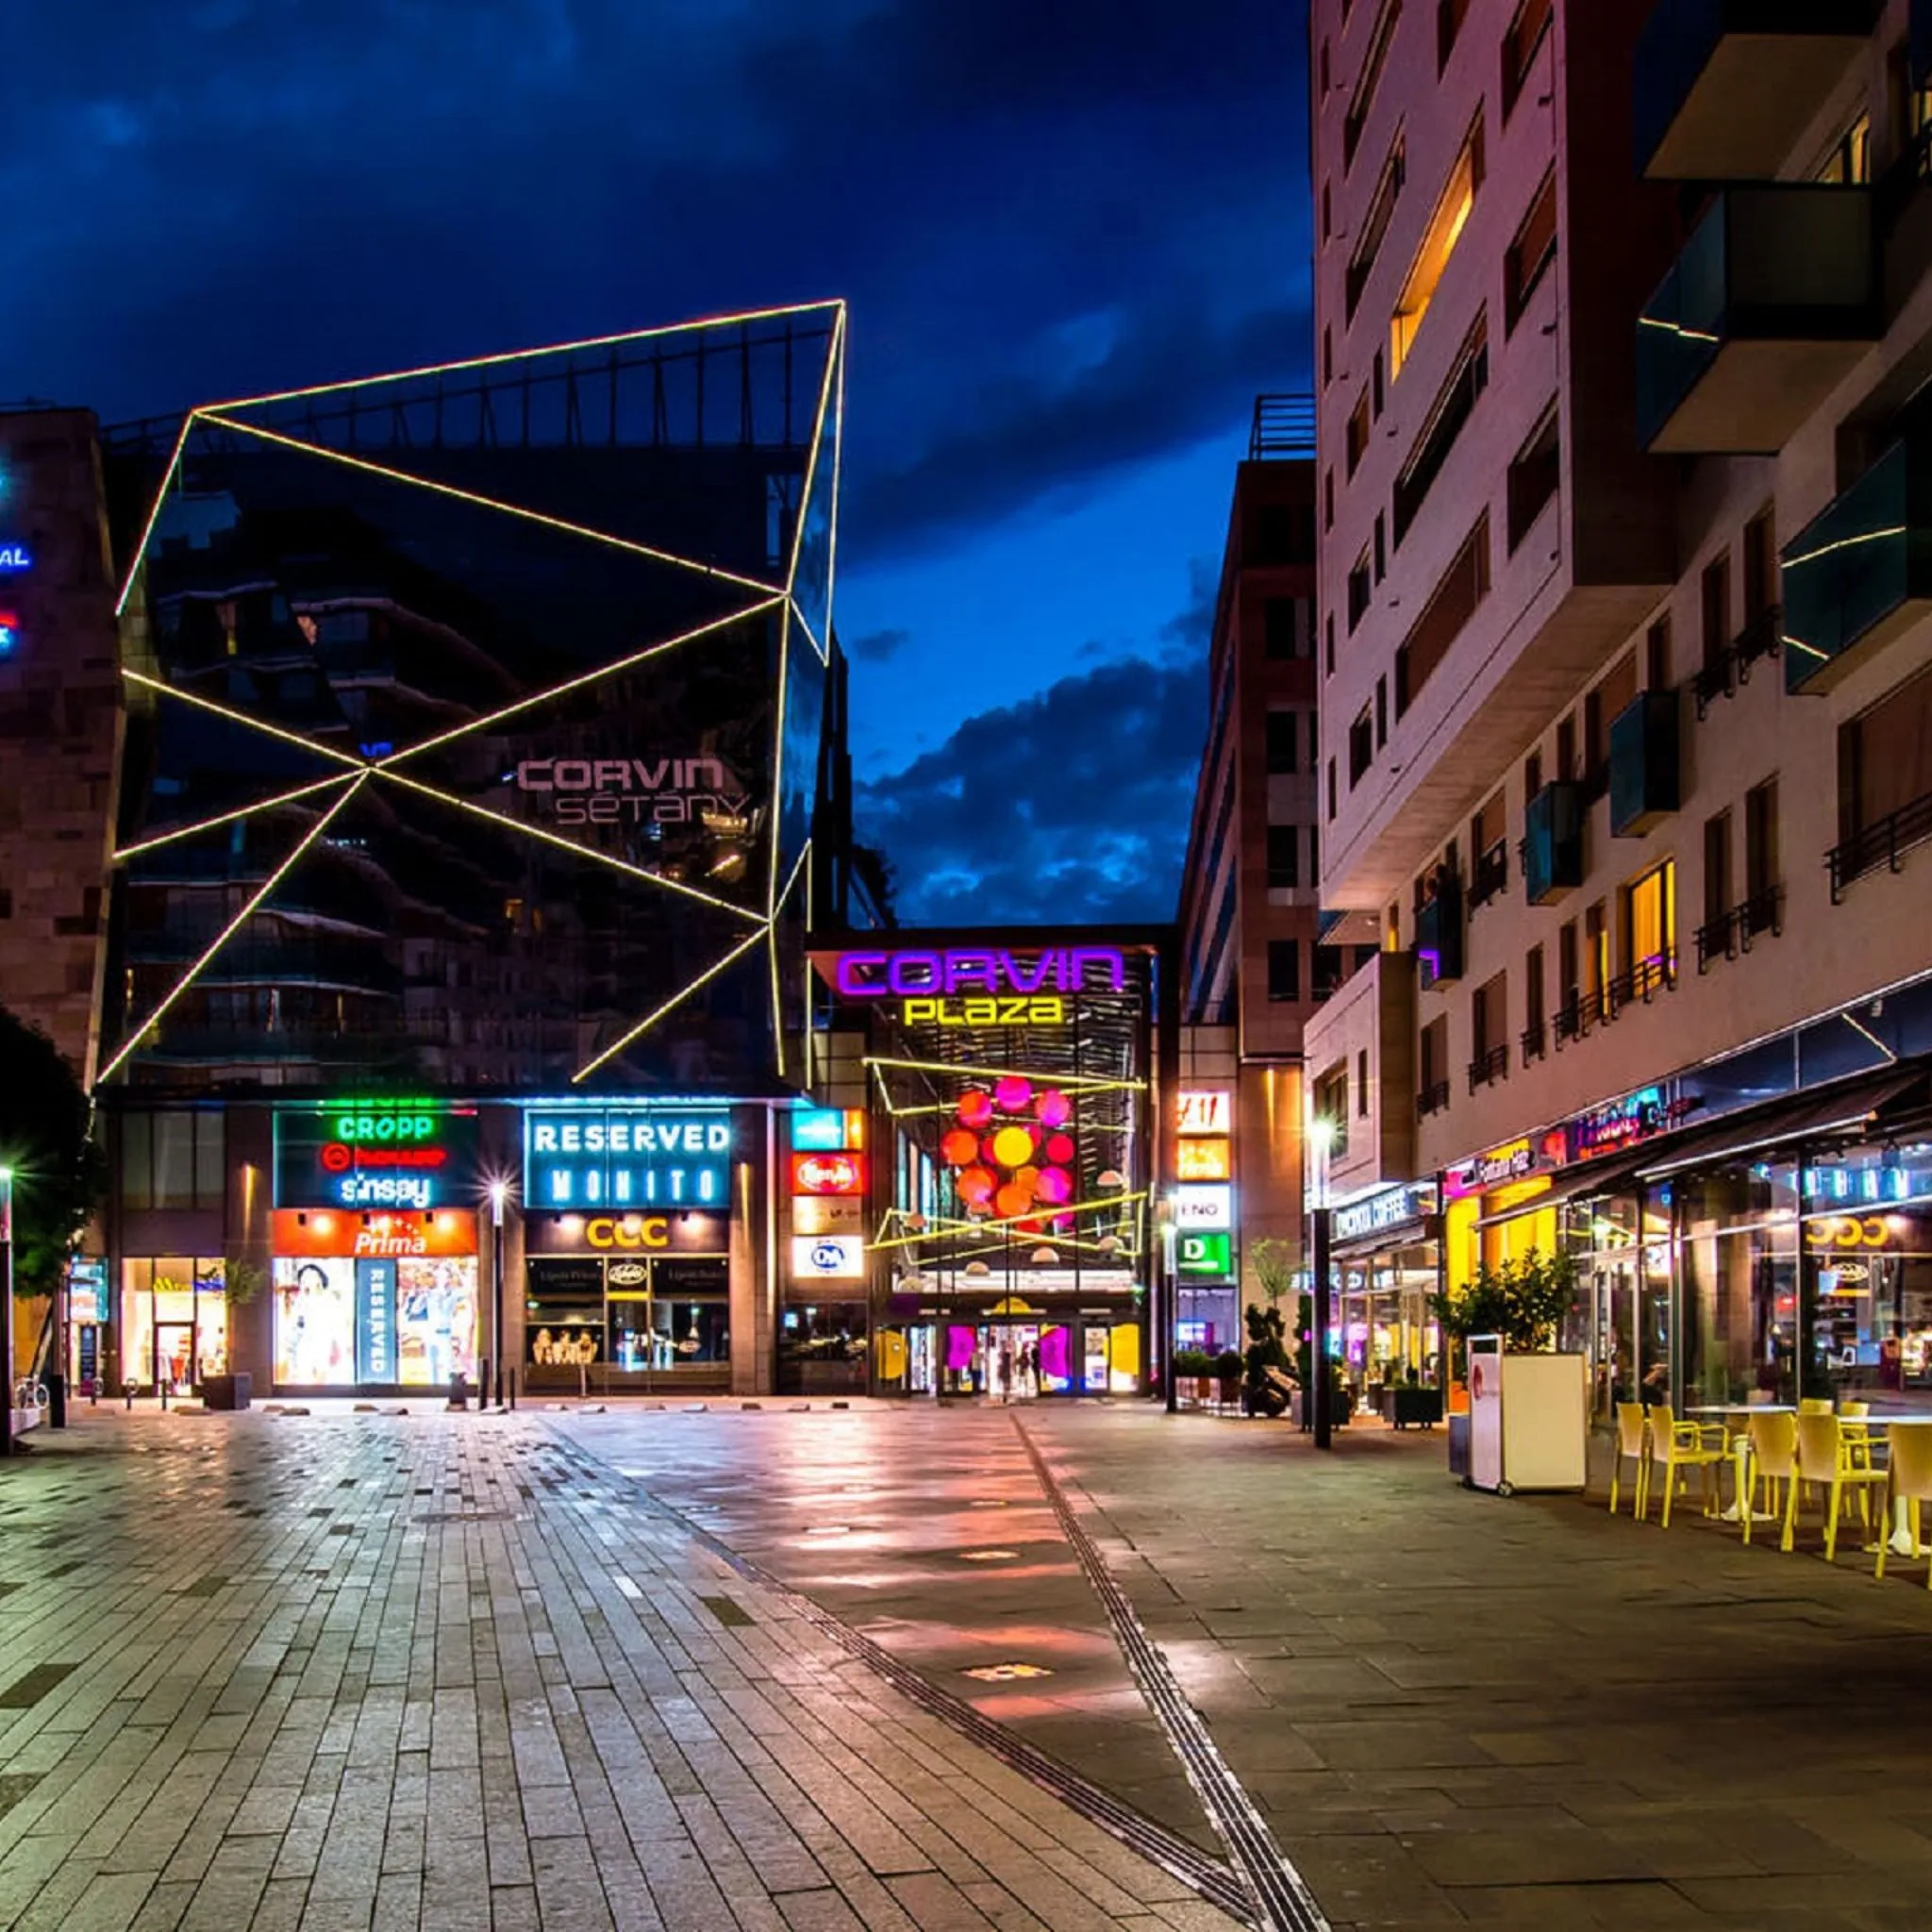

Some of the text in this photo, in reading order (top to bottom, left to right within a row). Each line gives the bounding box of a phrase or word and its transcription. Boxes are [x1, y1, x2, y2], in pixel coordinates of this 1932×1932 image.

[518, 758, 724, 791] CORVIN
[837, 948, 1124, 995] CORVIN
[337, 1116, 434, 1140] CROPP
[534, 1124, 731, 1152] RESERVED
[587, 1216, 669, 1247] CCC
